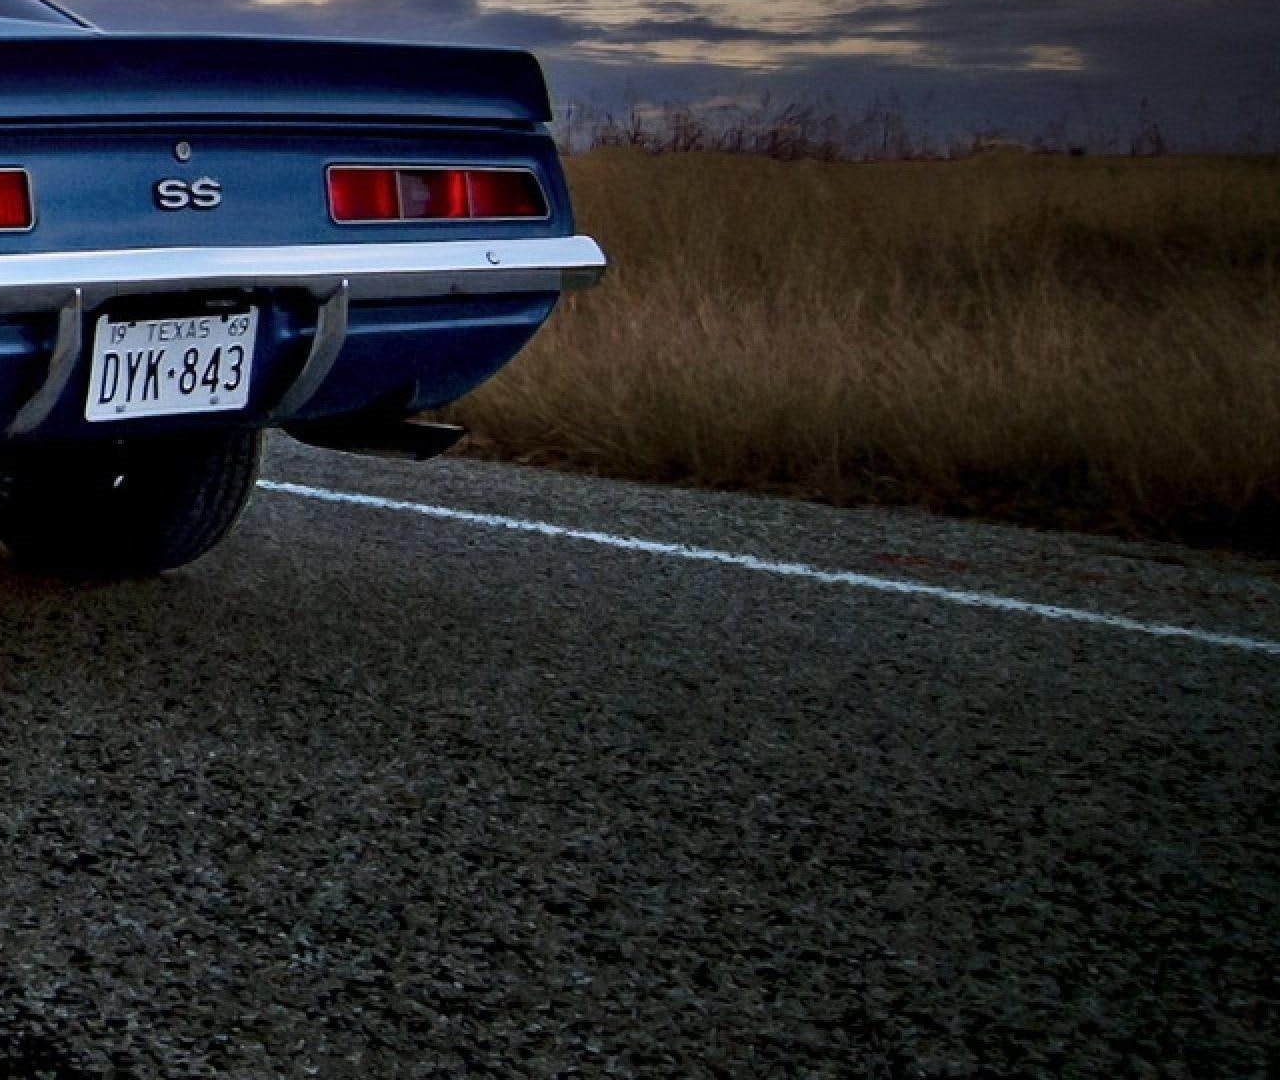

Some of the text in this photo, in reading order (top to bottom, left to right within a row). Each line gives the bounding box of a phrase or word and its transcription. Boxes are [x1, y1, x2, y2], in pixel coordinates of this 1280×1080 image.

[157, 177, 222, 208] SS
[110, 325, 127, 344] 19
[147, 319, 211, 341] TEXAS
